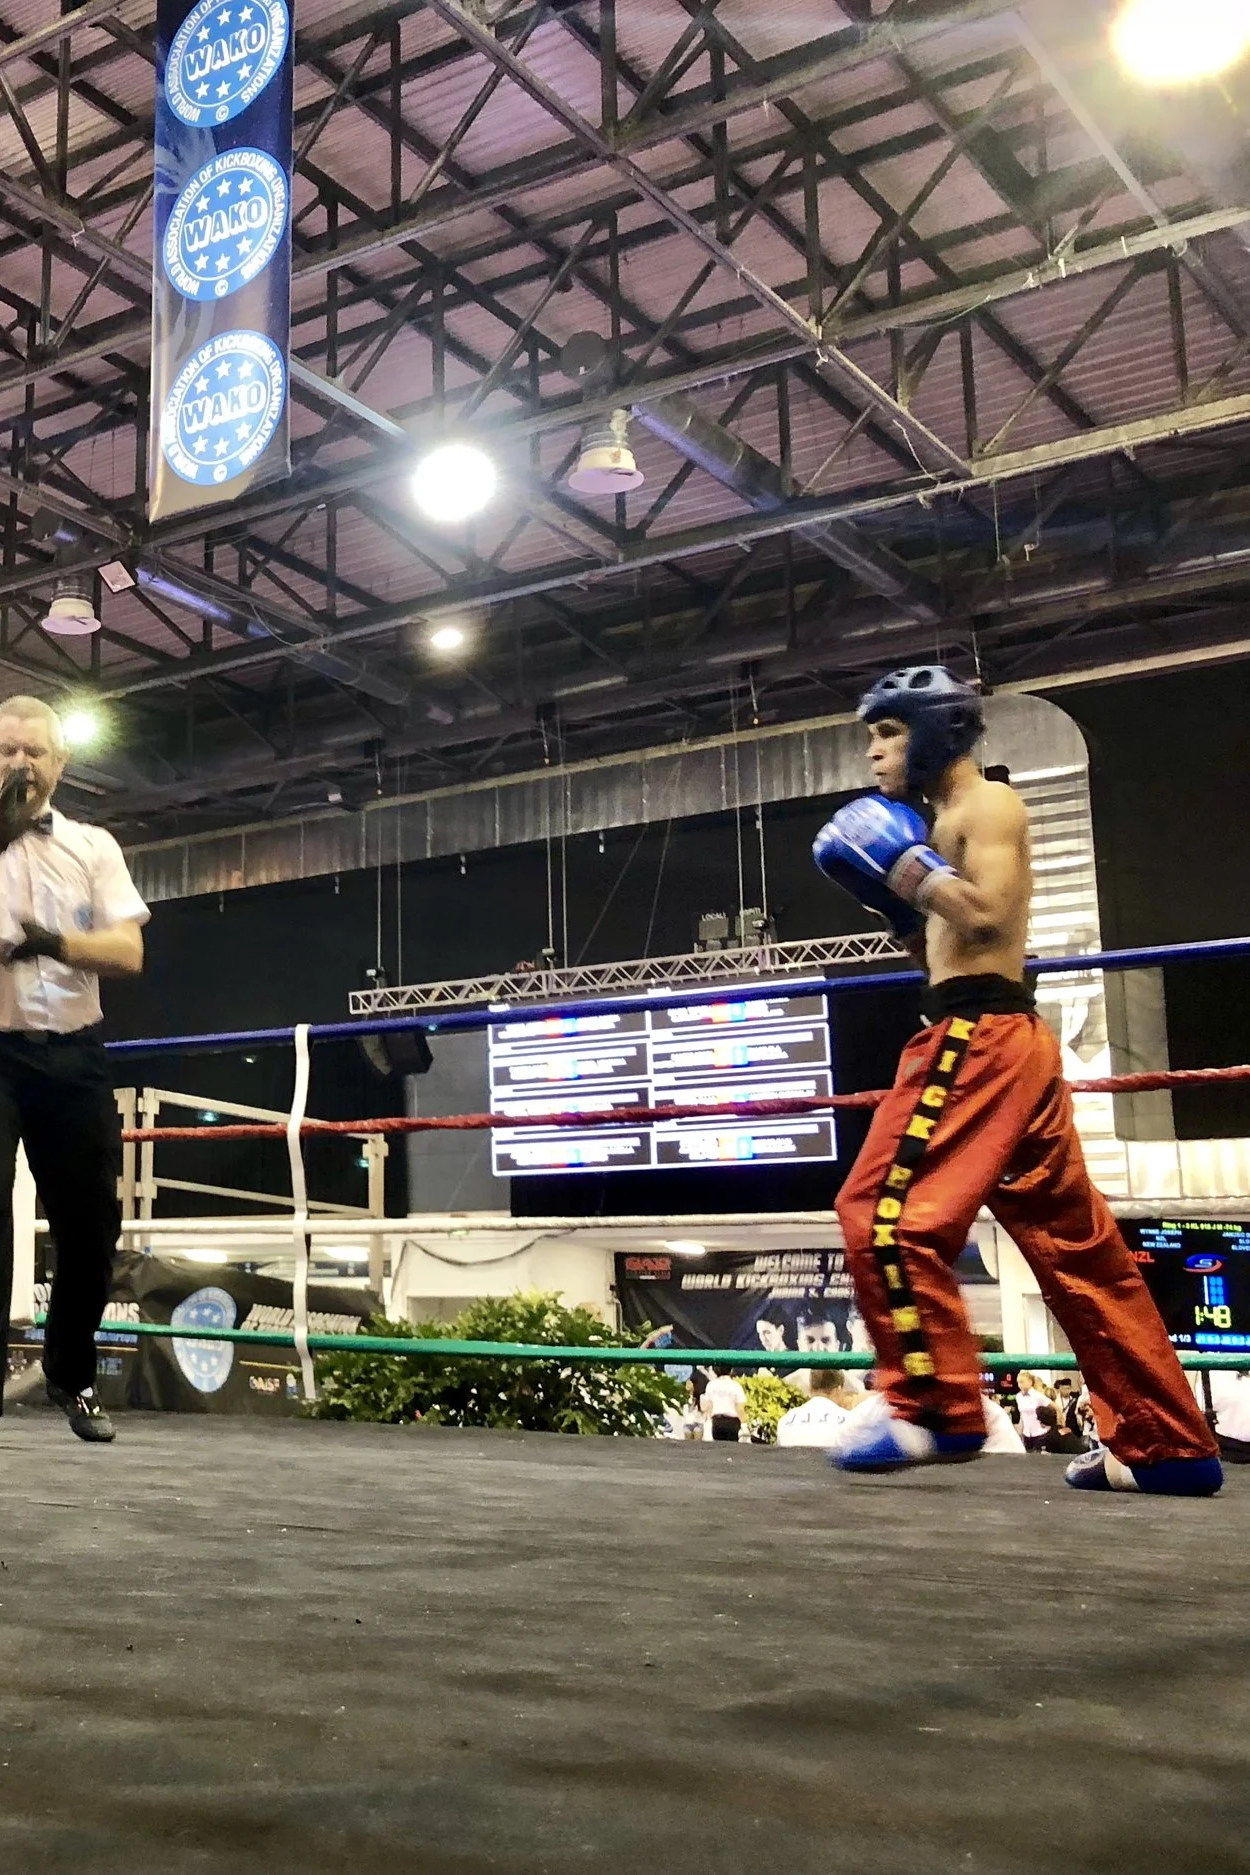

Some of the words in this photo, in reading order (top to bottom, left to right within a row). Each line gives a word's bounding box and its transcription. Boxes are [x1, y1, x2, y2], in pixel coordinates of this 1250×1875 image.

[168, 11, 200, 94] ASSOCIATION
[185, 23, 266, 81] WAKO
[241, 2, 285, 103] ORGANIZATIONS
[171, 93, 201, 122] WORLD
[200, 165, 213, 182] OF
[215, 152, 277, 181] KICKBOXING
[167, 179, 200, 264] ASSOCIATION
[184, 196, 268, 252] WAKO
[240, 177, 286, 280] ORGANIZATIONS
[199, 344, 213, 362] OF
[182, 380, 267, 434] WAKO
[681, 1274, 732, 1290] WORLD
[736, 1272, 825, 1290] KICKBOXING
[1195, 1305, 1231, 1328] 1:48
